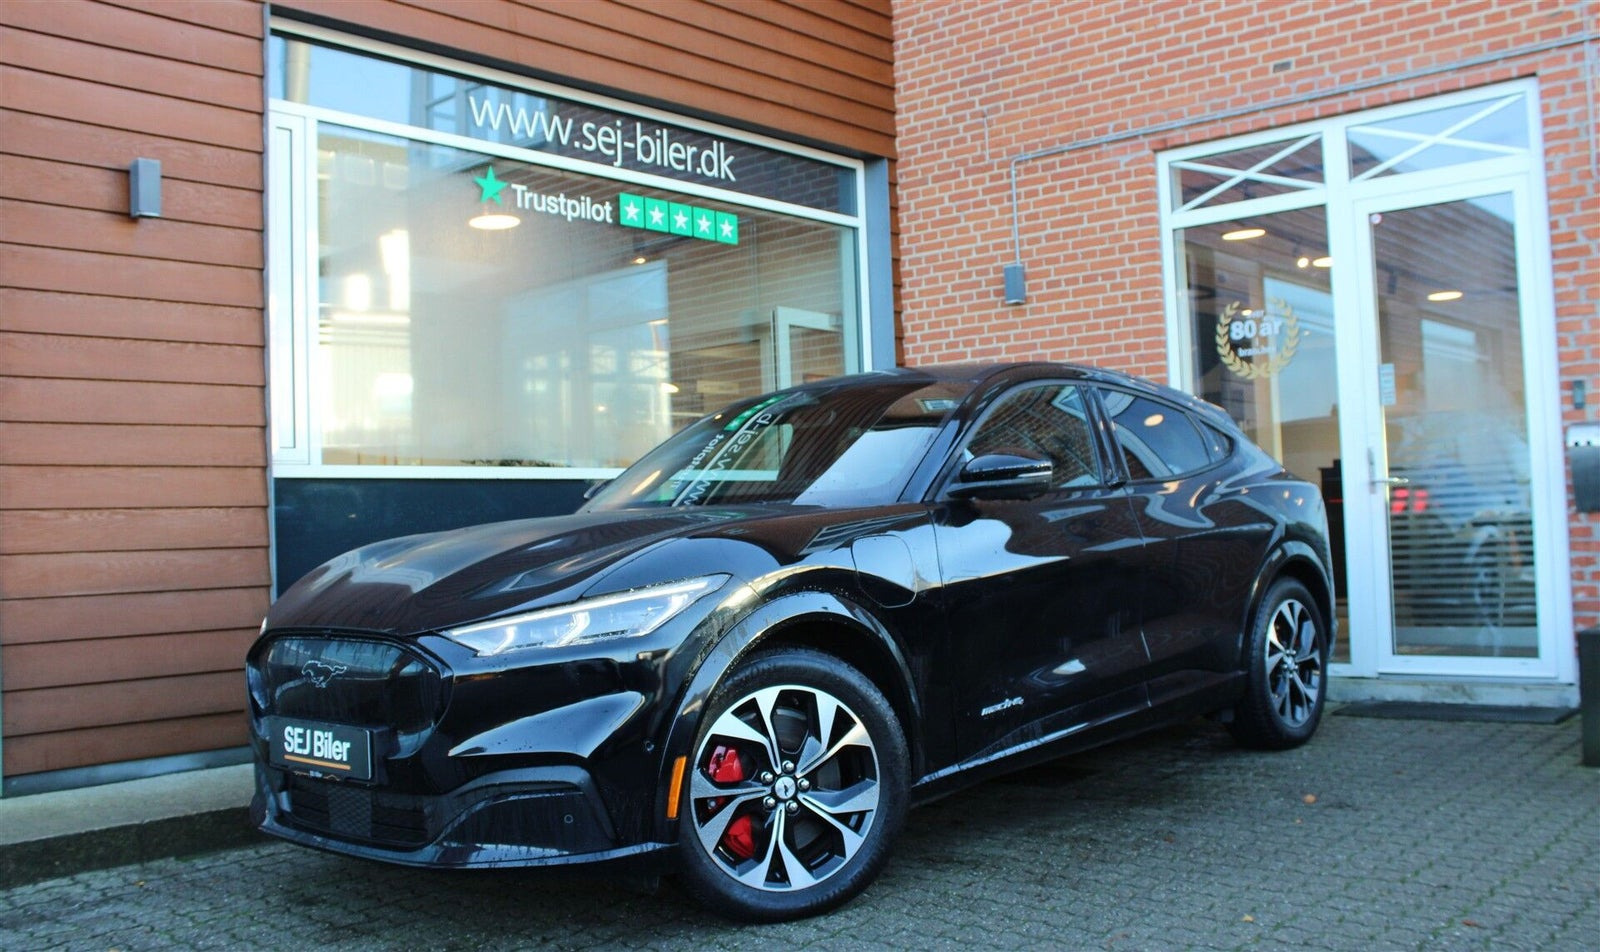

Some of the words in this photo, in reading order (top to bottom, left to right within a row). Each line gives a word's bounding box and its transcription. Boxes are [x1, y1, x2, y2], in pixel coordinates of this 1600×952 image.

[469, 96, 737, 182] www.sej-biler.dk
[511, 183, 613, 224] Trustpilot
[1229, 319, 1257, 341] 80
[284, 725, 312, 755] SEJ
[313, 730, 351, 761] Biler
